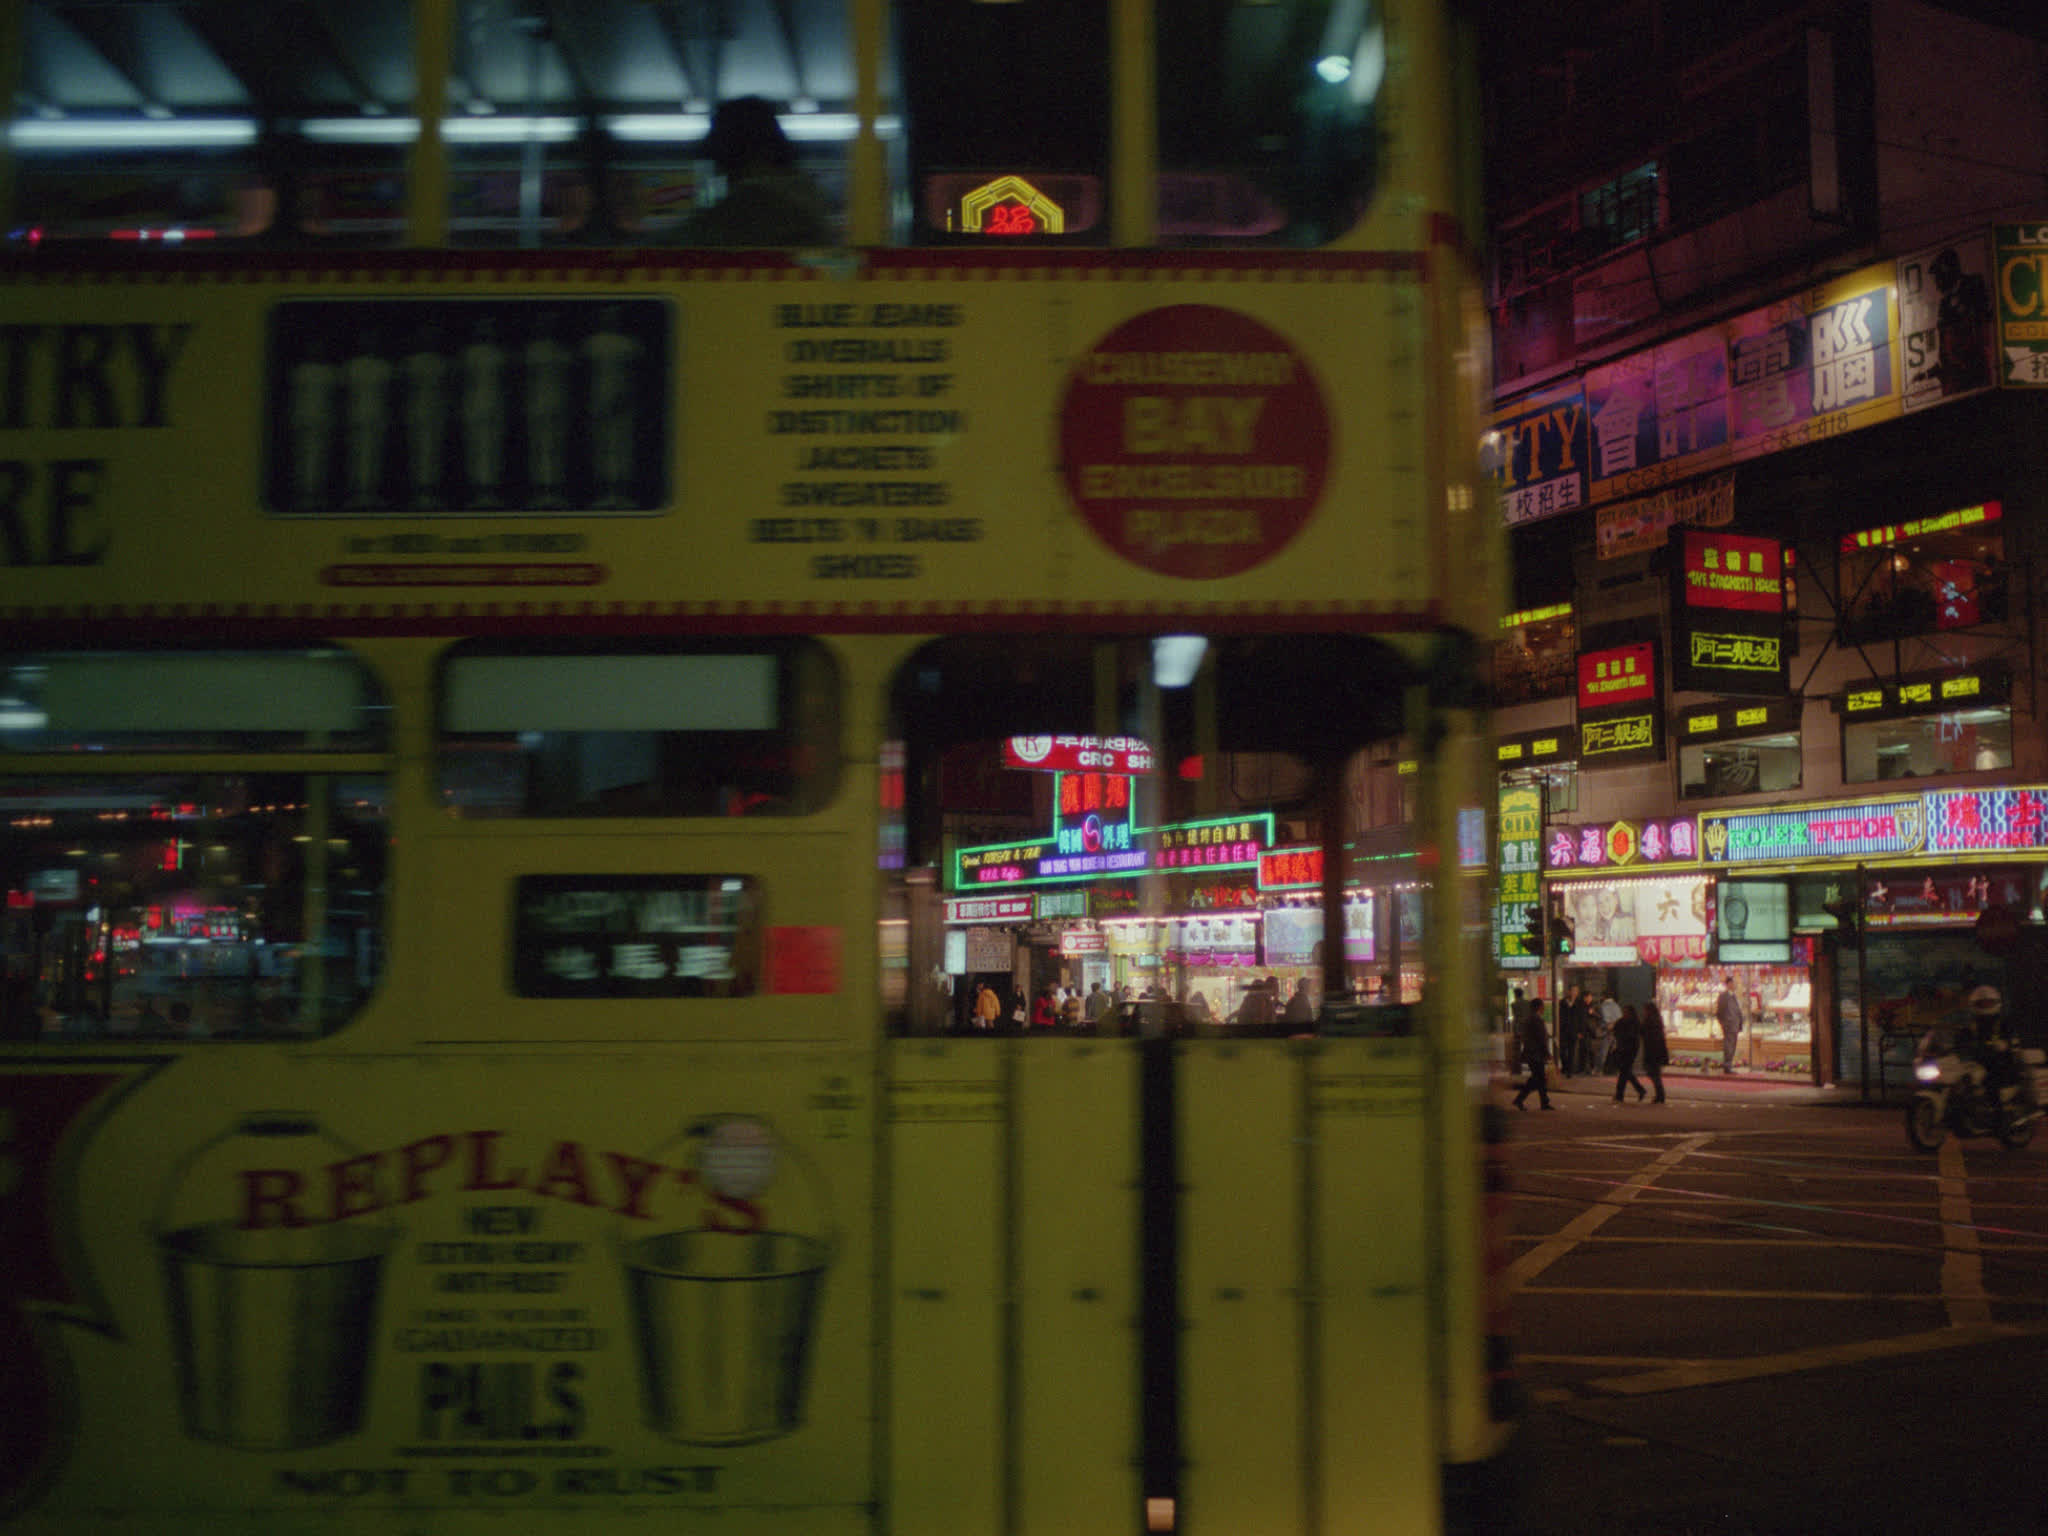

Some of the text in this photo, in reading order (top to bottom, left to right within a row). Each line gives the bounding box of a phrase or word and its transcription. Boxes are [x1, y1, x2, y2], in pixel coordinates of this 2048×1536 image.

[1125, 396, 1266, 454] BAY
[1078, 751, 1115, 767] CRC
[1502, 813, 1538, 831] CITY
[1728, 815, 1896, 850] ROLEX TUDOR
[446, 1467, 540, 1497] TO
[552, 1466, 726, 1497] RUST
